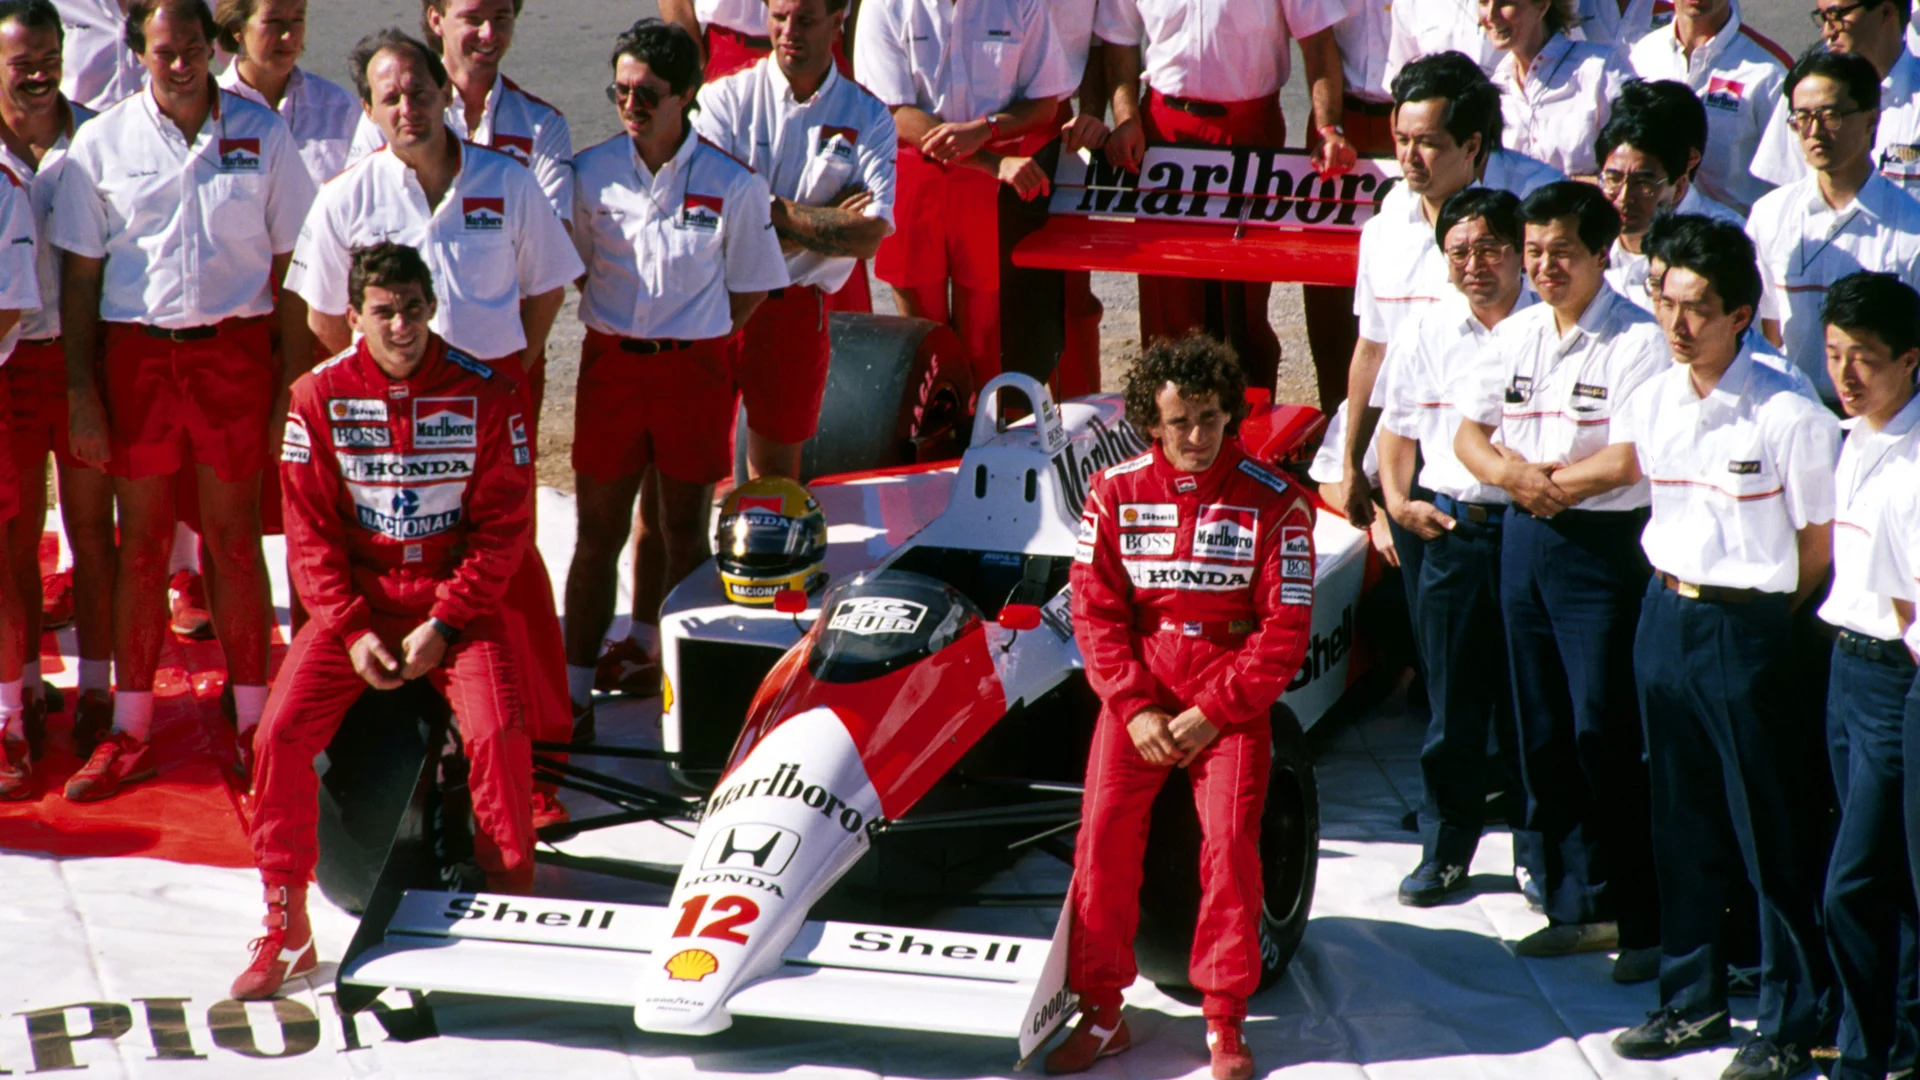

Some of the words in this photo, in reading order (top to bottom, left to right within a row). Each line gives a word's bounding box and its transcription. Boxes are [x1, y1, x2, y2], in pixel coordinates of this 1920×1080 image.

[337, 428, 386, 443] BOSS
[416, 417, 473, 437] Marlboro
[365, 460, 471, 476] HONDA
[362, 507, 455, 537] NACIONAL
[1125, 534, 1171, 549] BOSS
[1197, 526, 1253, 549] Marlboro
[1148, 569, 1249, 585] HONDA
[832, 615, 915, 630] HEUER
[702, 763, 862, 833] Marlboro
[683, 873, 785, 899] HONDA
[444, 897, 616, 930] Shell
[671, 894, 760, 945] 12
[849, 930, 1022, 964] Shell
